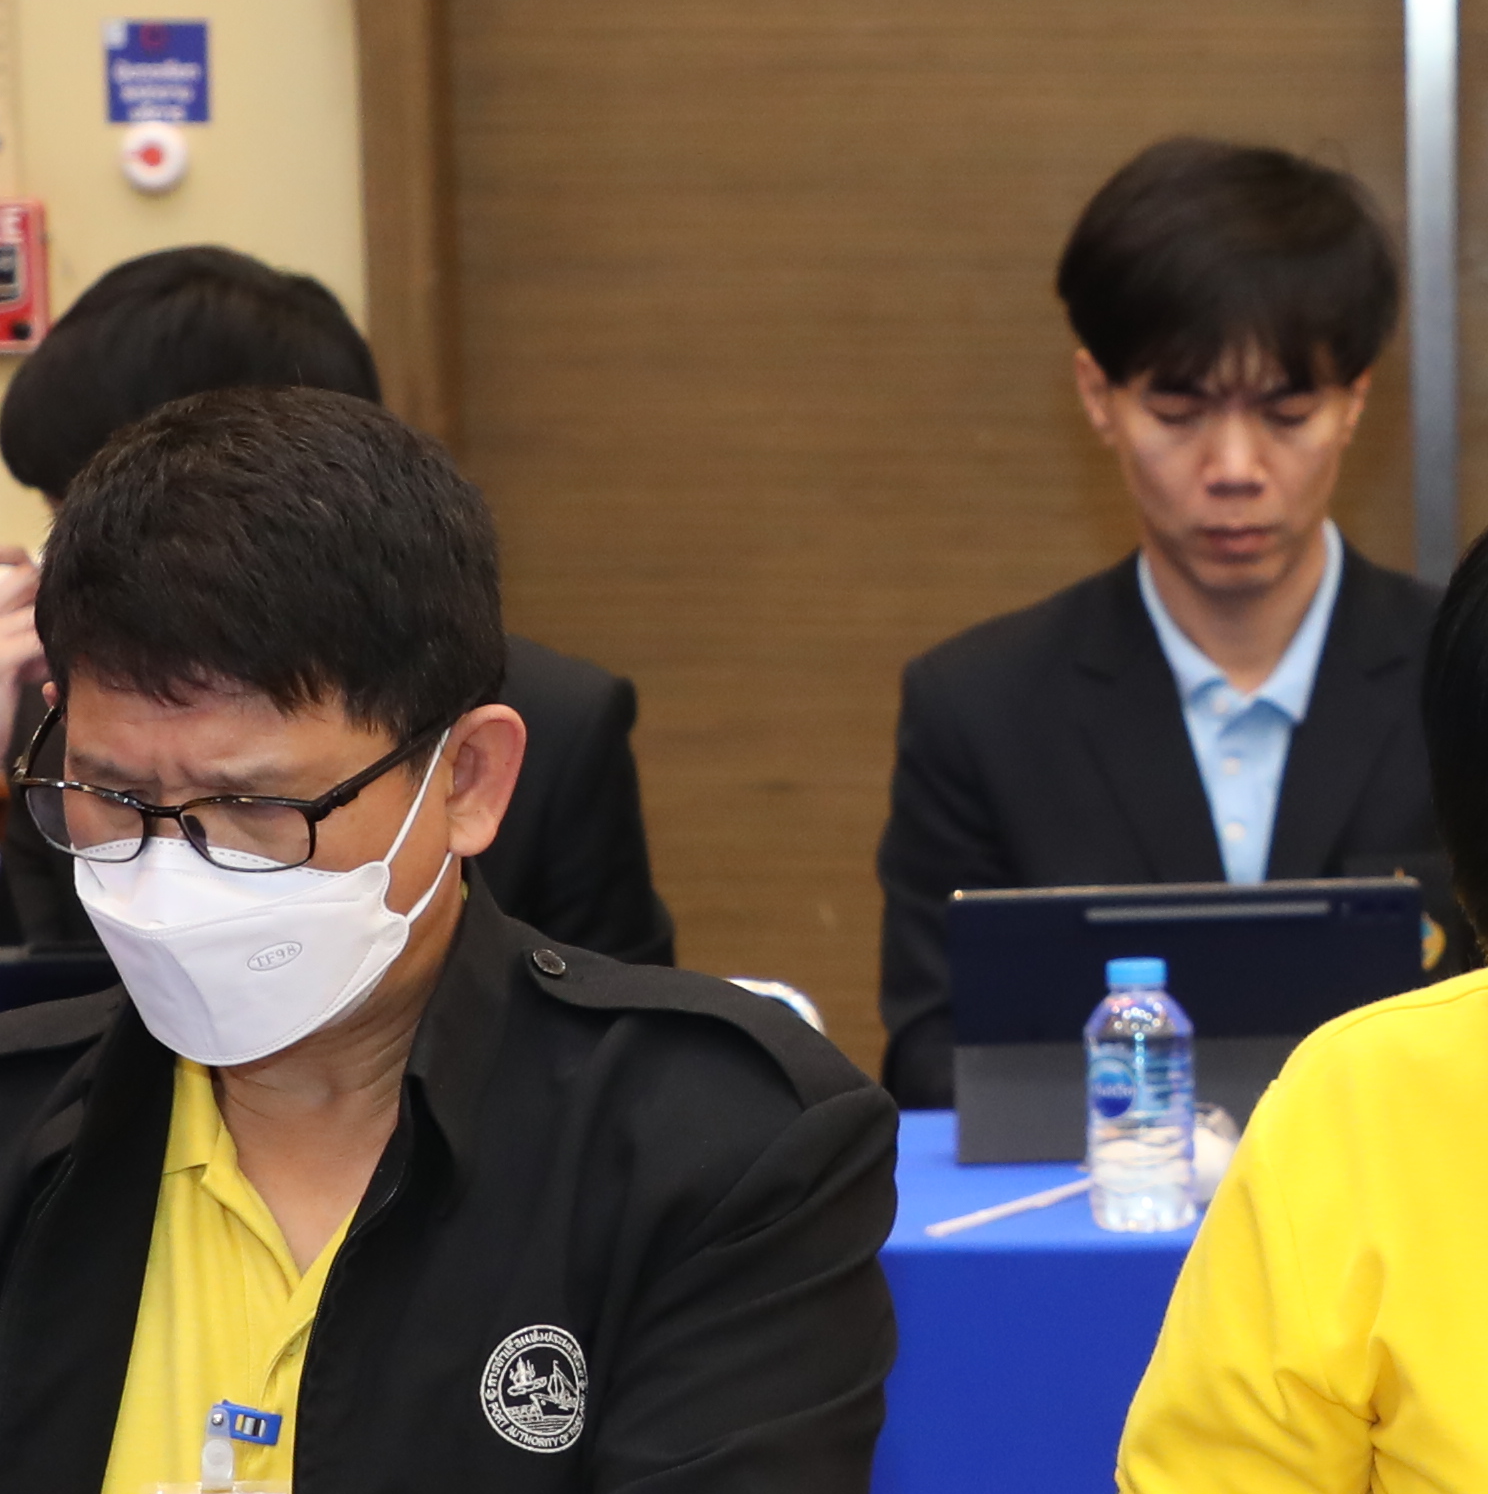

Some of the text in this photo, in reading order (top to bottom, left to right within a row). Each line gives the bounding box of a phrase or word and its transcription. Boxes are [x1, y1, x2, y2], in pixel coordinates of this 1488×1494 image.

[251, 944, 297, 967] TF98
[488, 1401, 510, 1428] PORT
[504, 1424, 559, 1448] AUTHORITY
